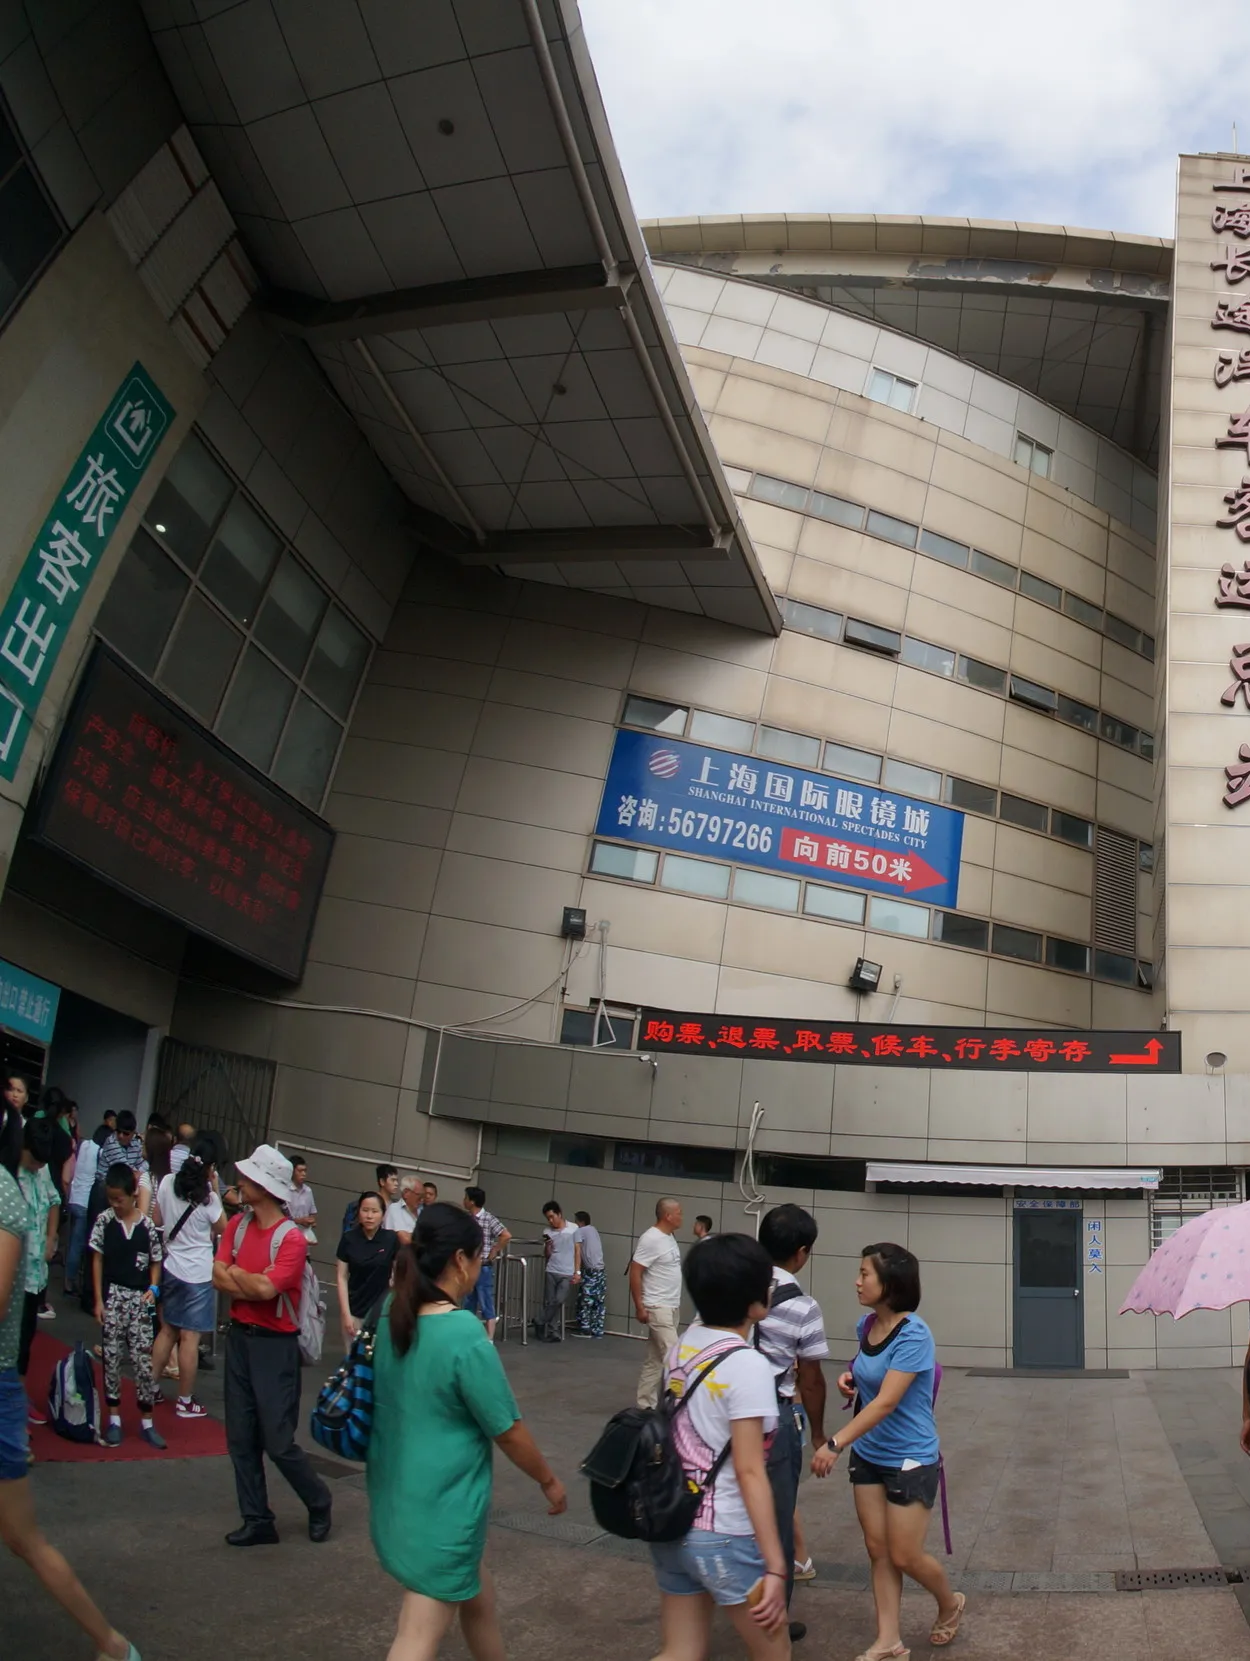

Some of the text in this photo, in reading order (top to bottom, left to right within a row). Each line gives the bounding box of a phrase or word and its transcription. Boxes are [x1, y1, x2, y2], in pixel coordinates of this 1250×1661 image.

[688, 786, 746, 807] SHANGHAI
[751, 799, 838, 828] INTERNATIONAL
[903, 835, 928, 850] CITY
[690, 755, 931, 838] 上海国际眼镜城
[793, 835, 914, 882] 向前50米
[1016, 1200, 1080, 1208] 安全保障部
[1087, 1221, 1102, 1273] 闲人莫入
